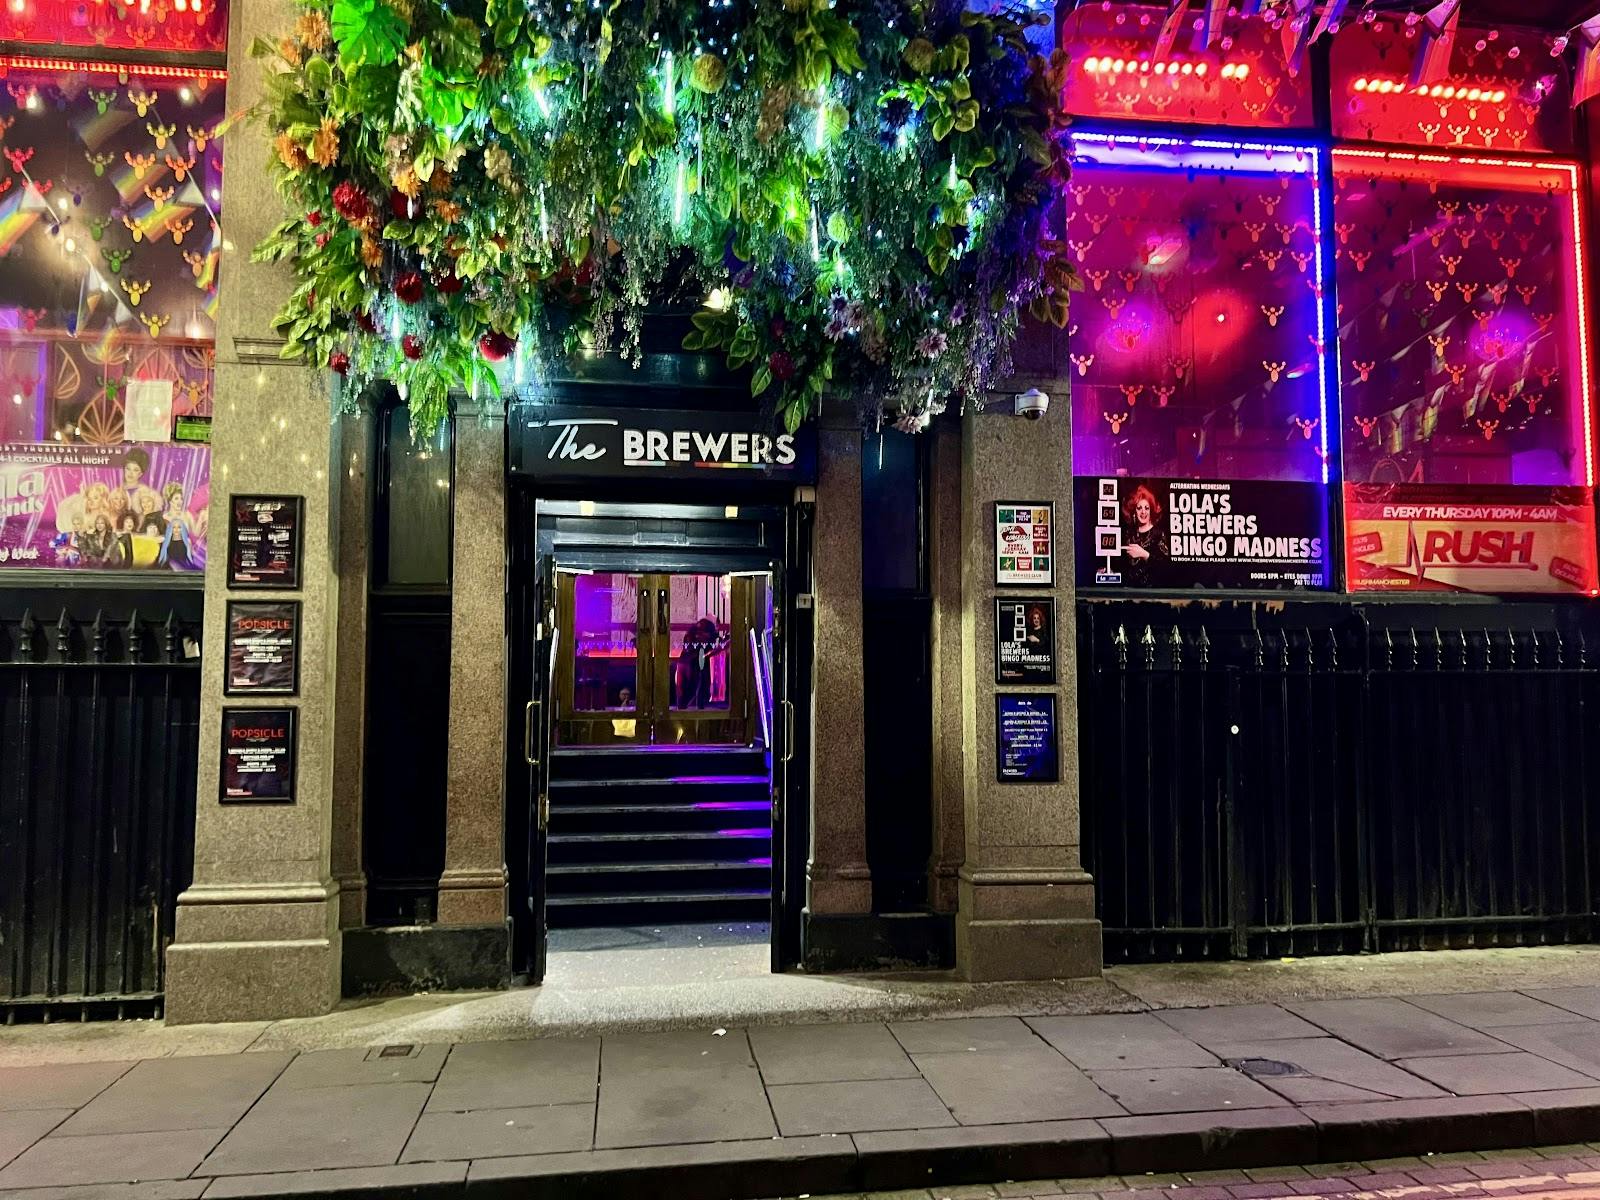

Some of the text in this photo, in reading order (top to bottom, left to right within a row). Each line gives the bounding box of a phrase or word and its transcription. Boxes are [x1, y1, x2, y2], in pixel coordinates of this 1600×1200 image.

[527, 419, 797, 465] The BREWERS
[23, 446, 79, 454] THURSDAY
[95, 447, 121, 455] 10PM
[13, 455, 62, 464] COCKTAILS
[64, 456, 80, 464] ALL
[82, 457, 110, 465] NIGHT
[1169, 493, 1231, 514] LOLA'S
[1383, 506, 1424, 518] EVERY
[1425, 506, 1490, 519] THURSDAY
[1490, 508, 1522, 519] 10PM
[1529, 508, 1558, 519] 4AM
[1170, 513, 1258, 535] BREWERS
[1170, 535, 1322, 558] BINGO MADNESS
[1423, 530, 1534, 563] RUSH
[238, 619, 290, 630] POPSICLE
[1000, 641, 1021, 649] LOLA'S
[1001, 648, 1030, 656] BREWERS
[231, 728, 285, 738] POPSICLE
